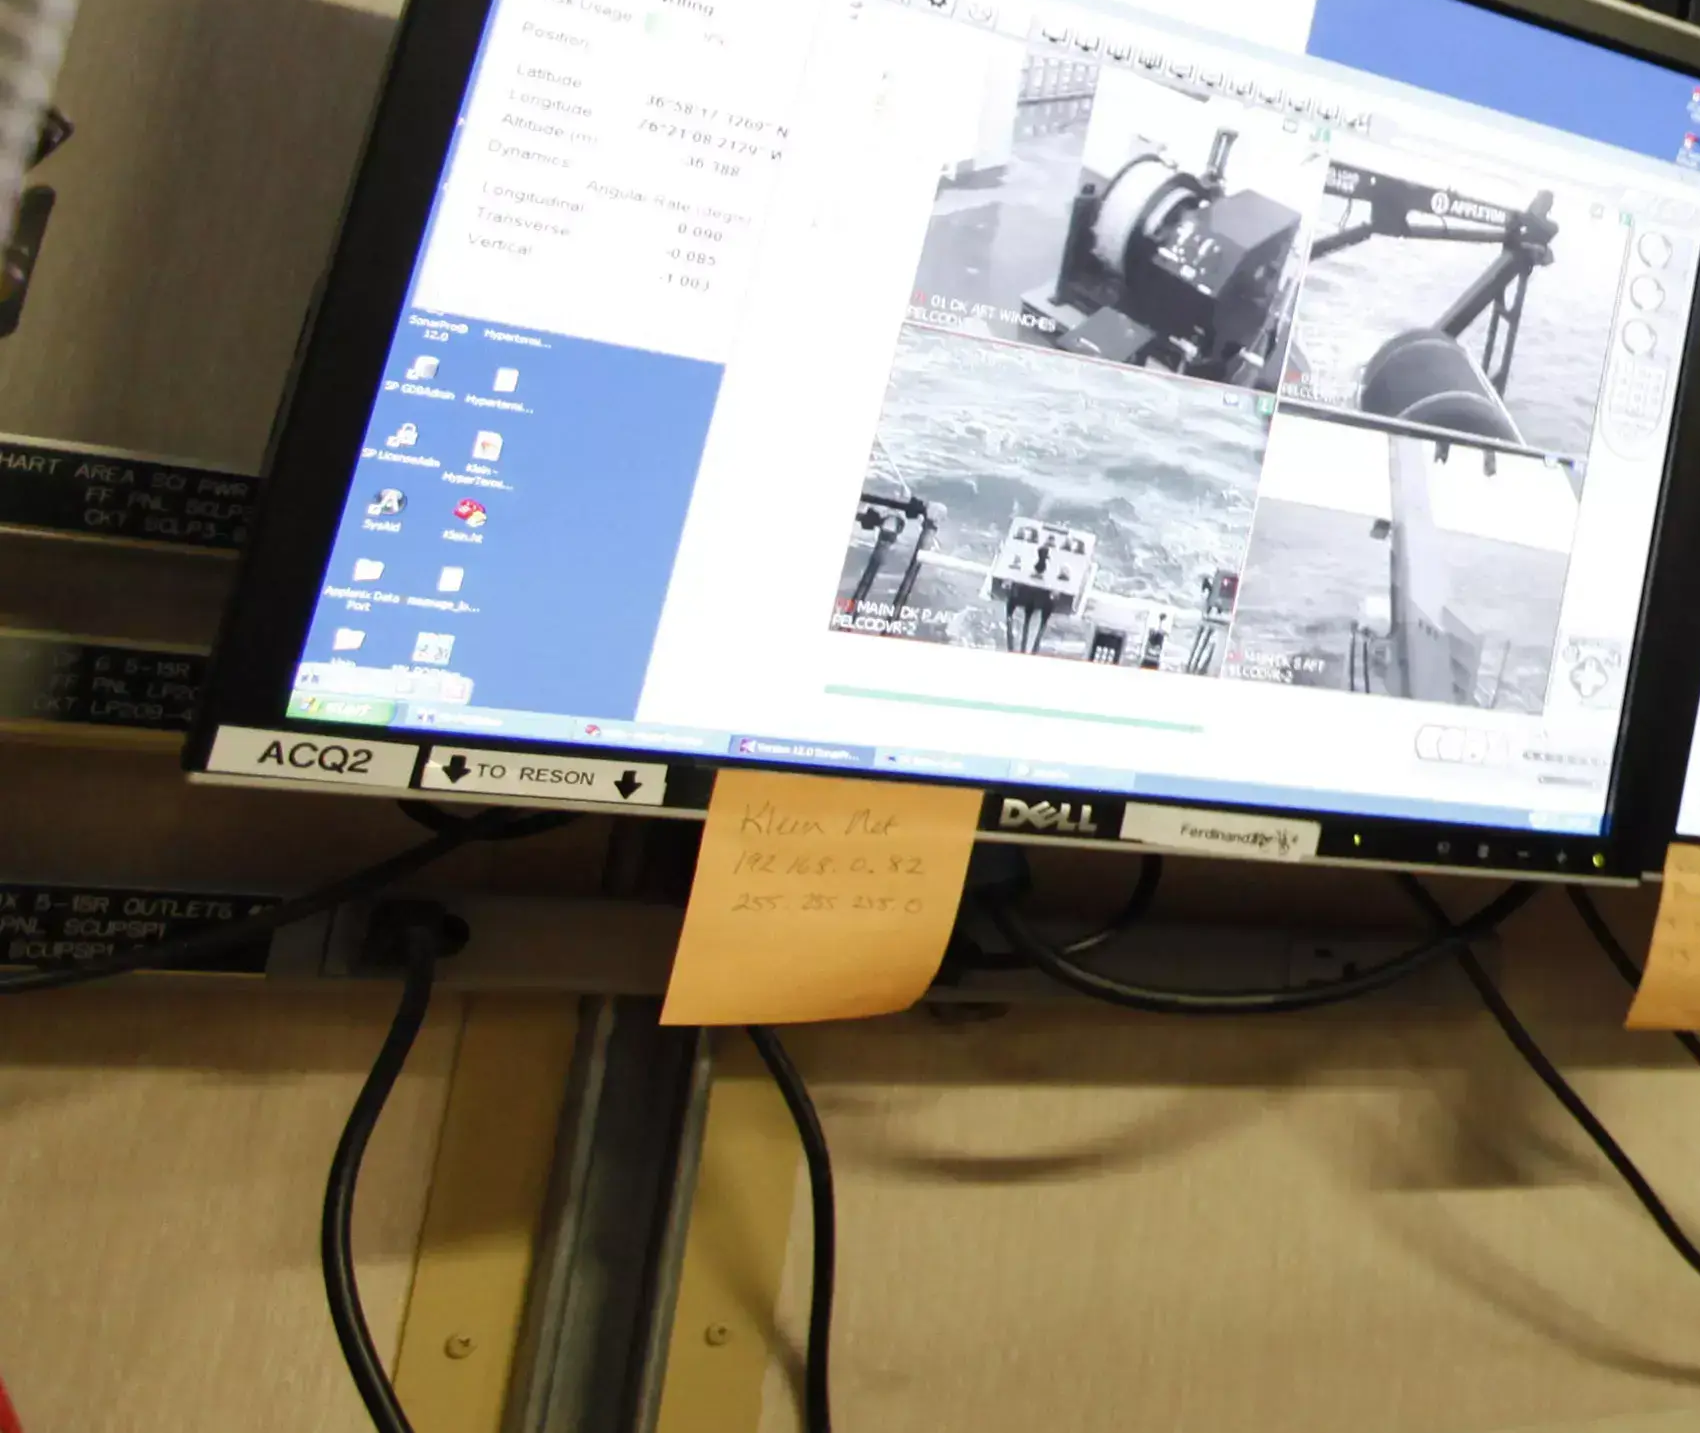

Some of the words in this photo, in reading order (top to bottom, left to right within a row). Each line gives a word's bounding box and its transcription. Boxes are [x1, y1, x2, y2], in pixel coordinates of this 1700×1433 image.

[521, 20, 590, 50] Position
[516, 62, 583, 90] Latitude
[508, 88, 593, 118] Longitude
[501, 112, 565, 139] Altitude
[775, 125, 790, 140] N
[488, 138, 572, 169] Dynamics
[482, 180, 585, 214] Longitudinal
[586, 178, 646, 206] Angular
[653, 193, 691, 215] Rate
[476, 205, 571, 237] Transverse
[468, 232, 533, 257] Vertical
[74, 462, 135, 485] AREA
[857, 600, 896, 618] MAIN
[257, 739, 373, 774] ACQ2
[477, 762, 507, 781] TO
[518, 765, 596, 787] RESON
[1000, 797, 1098, 833] DELL
